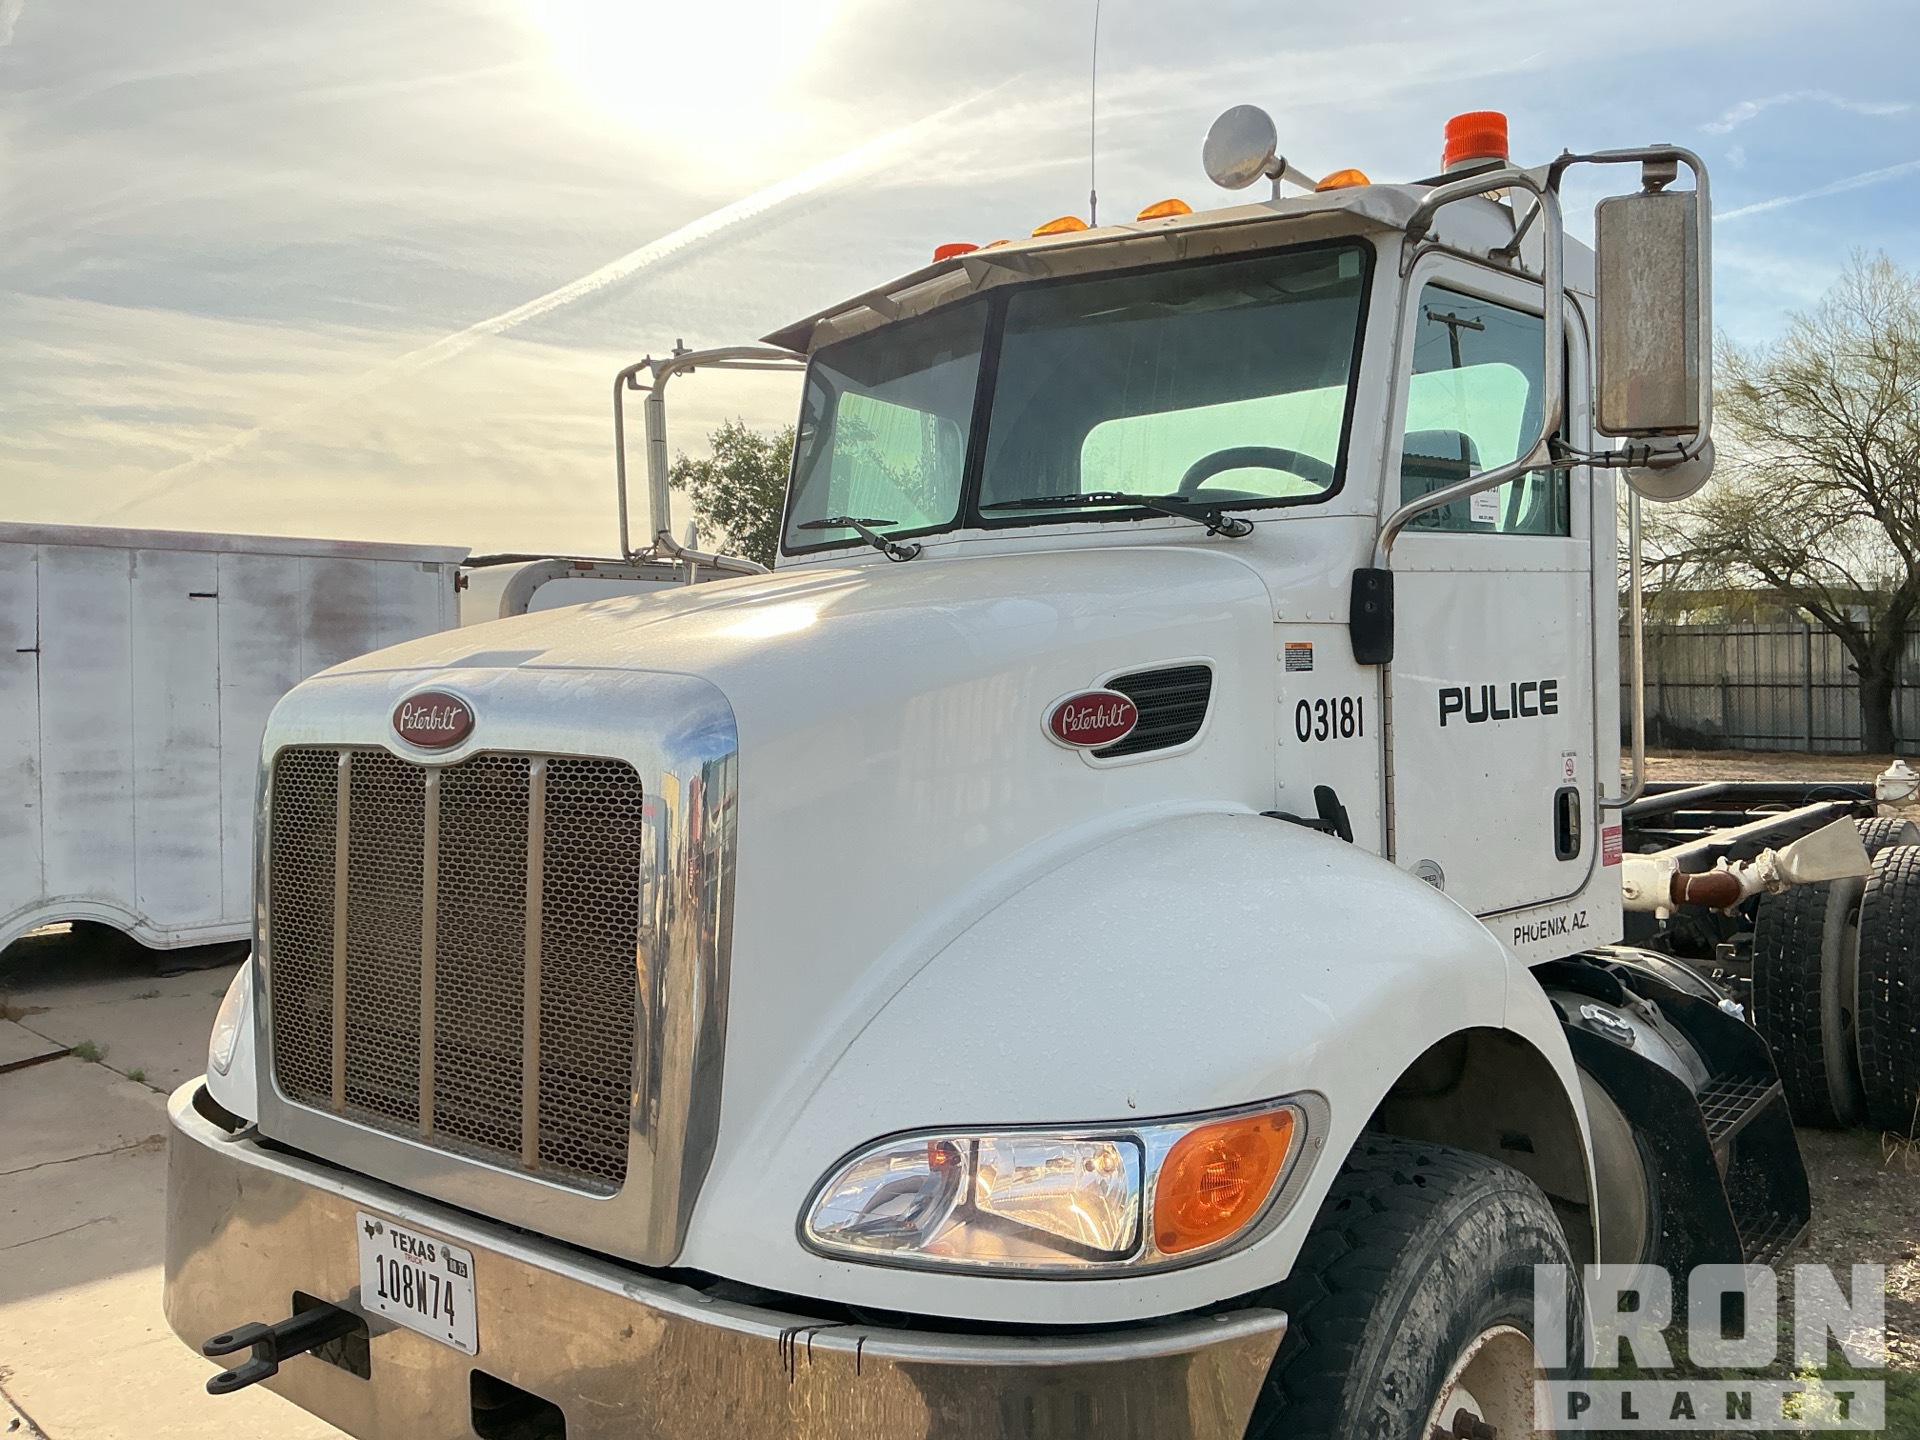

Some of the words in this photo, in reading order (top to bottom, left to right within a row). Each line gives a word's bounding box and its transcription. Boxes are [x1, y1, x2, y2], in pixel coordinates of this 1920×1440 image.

[400, 702, 463, 733] Peterbilt
[1062, 704, 1131, 735] Peterbilt
[1294, 695, 1364, 743] 03181
[1438, 679, 1559, 728] PULICE
[390, 1229, 436, 1263] TEXAS
[404, 1252, 424, 1267] TRUCK
[376, 1254, 455, 1327] 108W74
